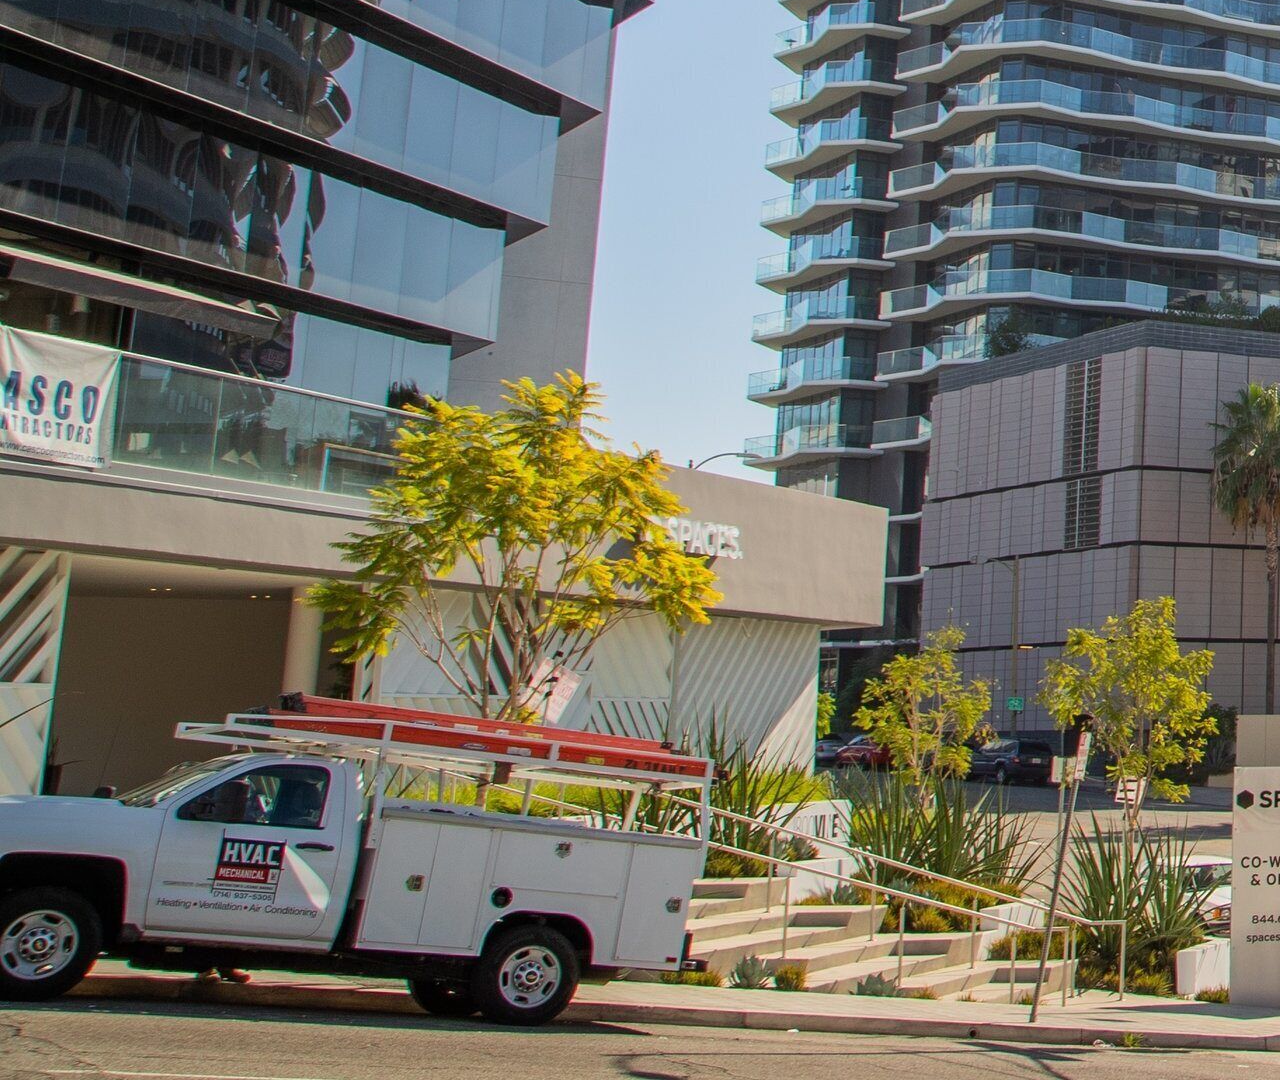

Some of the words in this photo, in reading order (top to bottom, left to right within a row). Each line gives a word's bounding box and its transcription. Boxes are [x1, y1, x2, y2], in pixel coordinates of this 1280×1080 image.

[218, 867, 265, 880] MECHANICAL
[1250, 873, 1261, 886] &
[156, 896, 192, 909] Heating
[199, 900, 243, 912] Ventilation
[248, 903, 261, 913] Air
[264, 904, 318, 918] Conditioning
